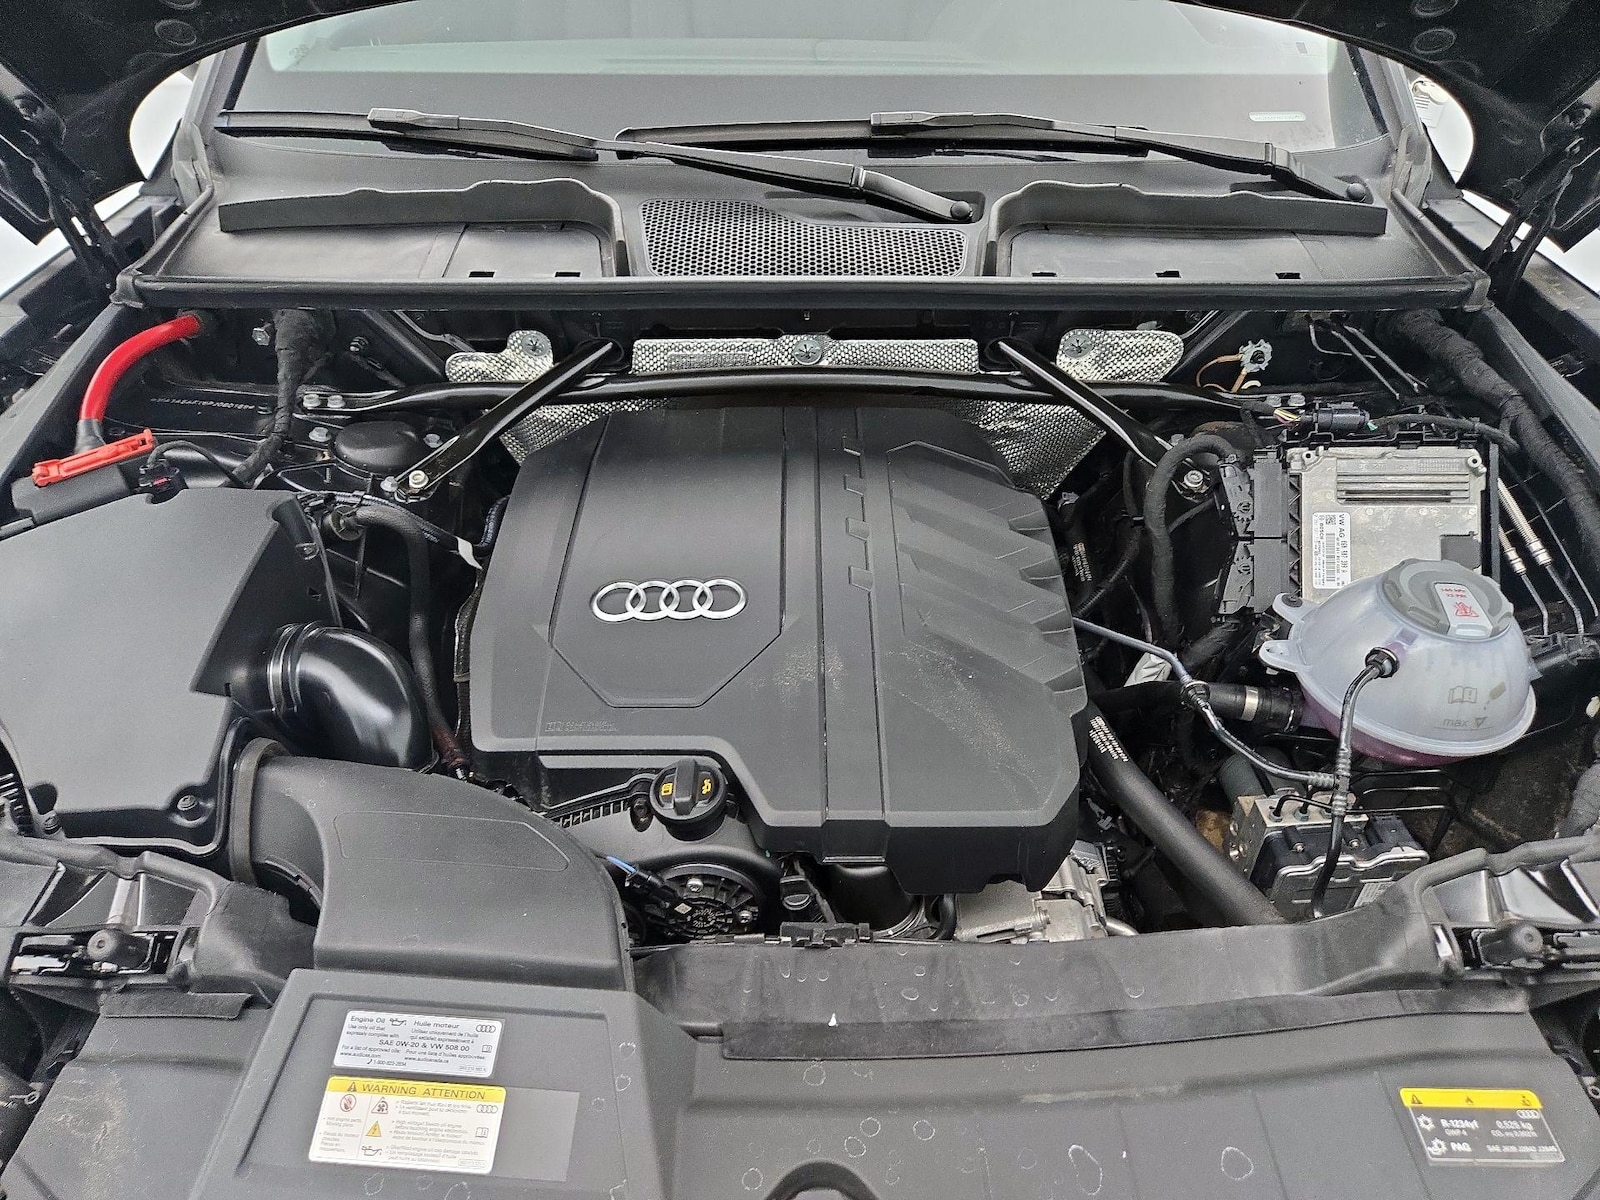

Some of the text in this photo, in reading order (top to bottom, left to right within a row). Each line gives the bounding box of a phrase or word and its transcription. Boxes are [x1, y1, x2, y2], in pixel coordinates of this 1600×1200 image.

[1338, 513, 1345, 526] VW
[1338, 527, 1346, 538] AG
[1442, 718, 1469, 728] max
[350, 1015, 374, 1024] Engine
[413, 1020, 431, 1028] Huile
[395, 1040, 420, 1048] 0W-20
[362, 1083, 486, 1100] WARNING ATTENTION
[1449, 1141, 1473, 1153] PAG
